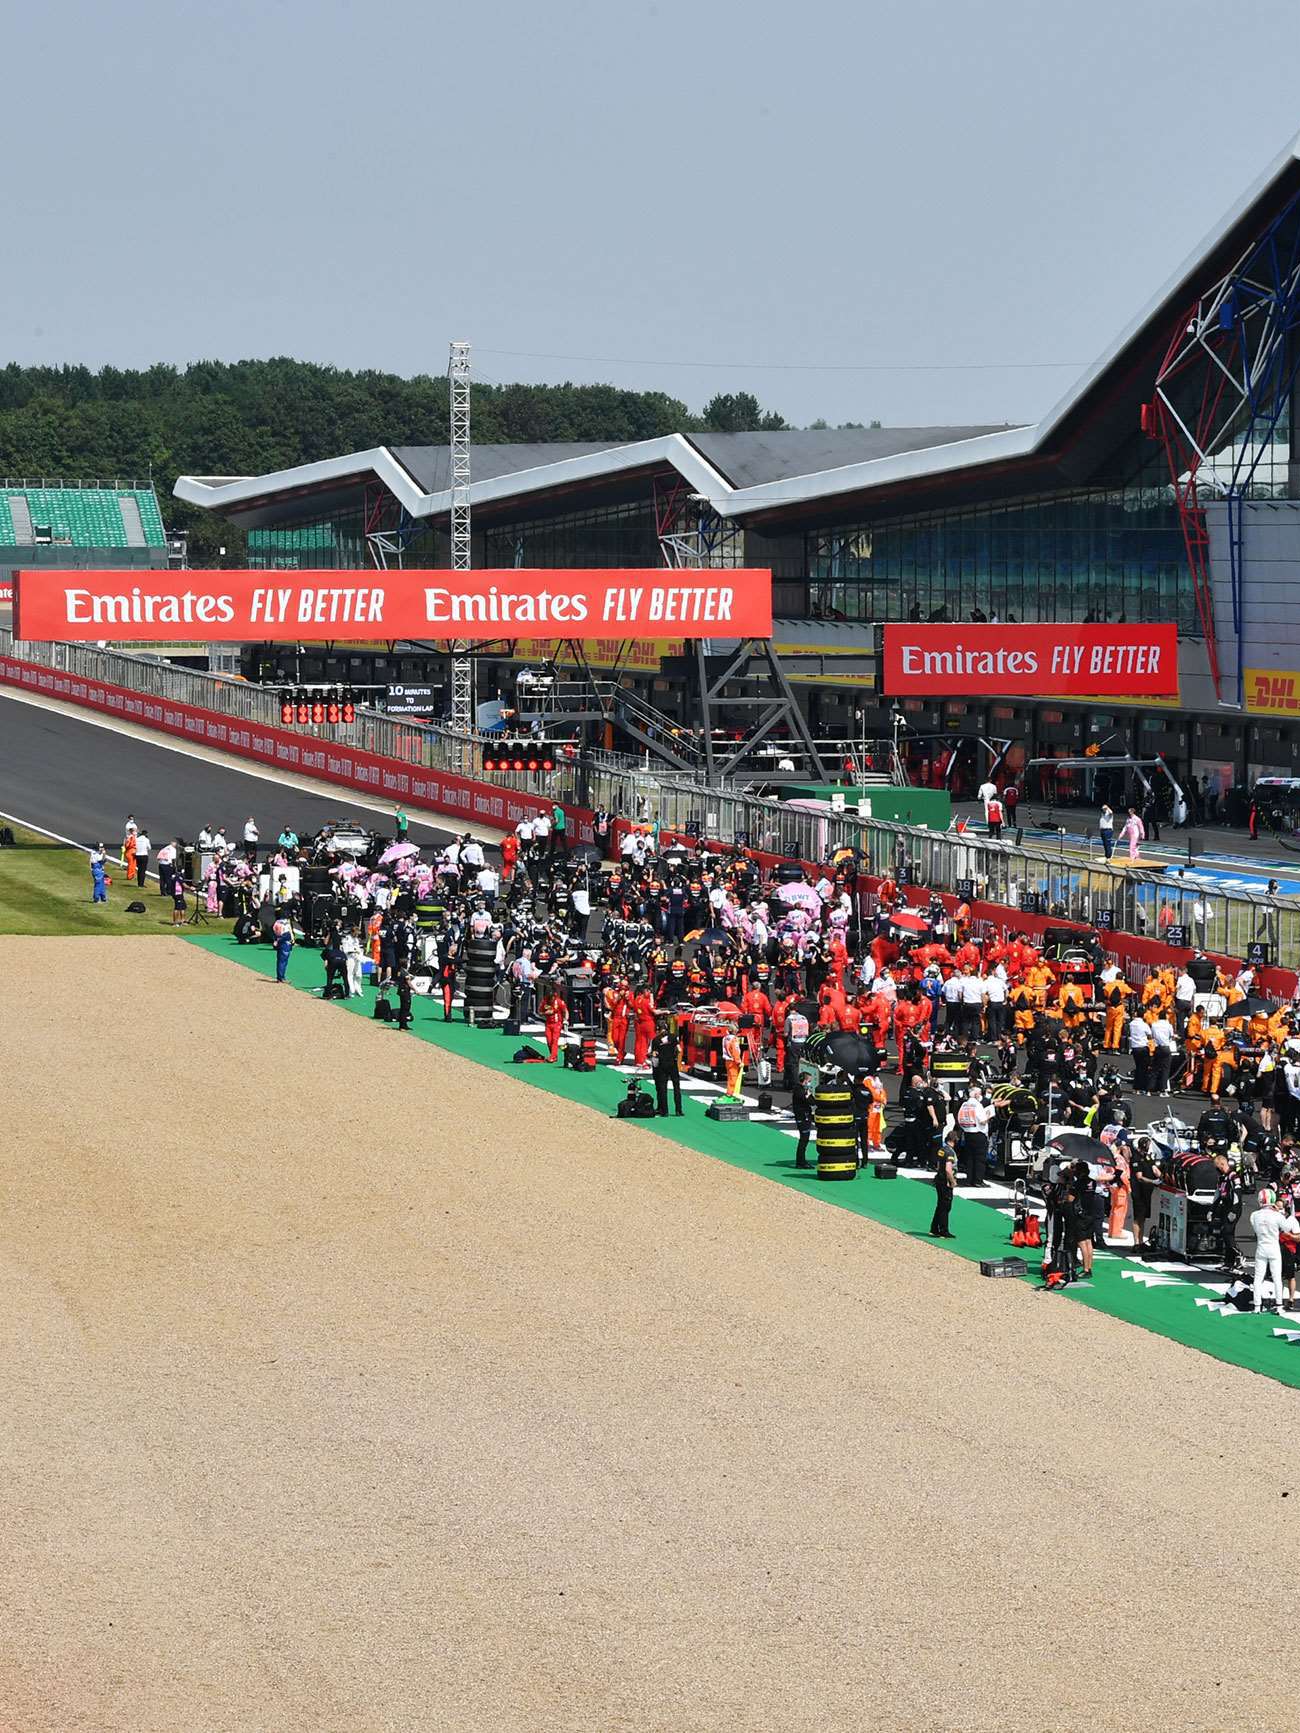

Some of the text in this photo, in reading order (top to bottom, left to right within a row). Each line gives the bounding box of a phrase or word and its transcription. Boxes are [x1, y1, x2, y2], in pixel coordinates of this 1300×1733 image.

[64, 587, 385, 623] Emirates FLY BETTER
[424, 586, 734, 622] Emirates FLY BETTER
[901, 643, 1161, 675] Emirates FLY BETTER
[389, 685, 431, 696] 10 MINUTES
[1255, 677, 1298, 708] DHL
[784, 843, 796, 852] 27
[899, 868, 906, 878] 3
[957, 880, 971, 891] 18
[1023, 895, 1036, 905] 10
[1097, 911, 1110, 922] 16
[1167, 927, 1183, 938] 23
[1252, 945, 1262, 956] 4
